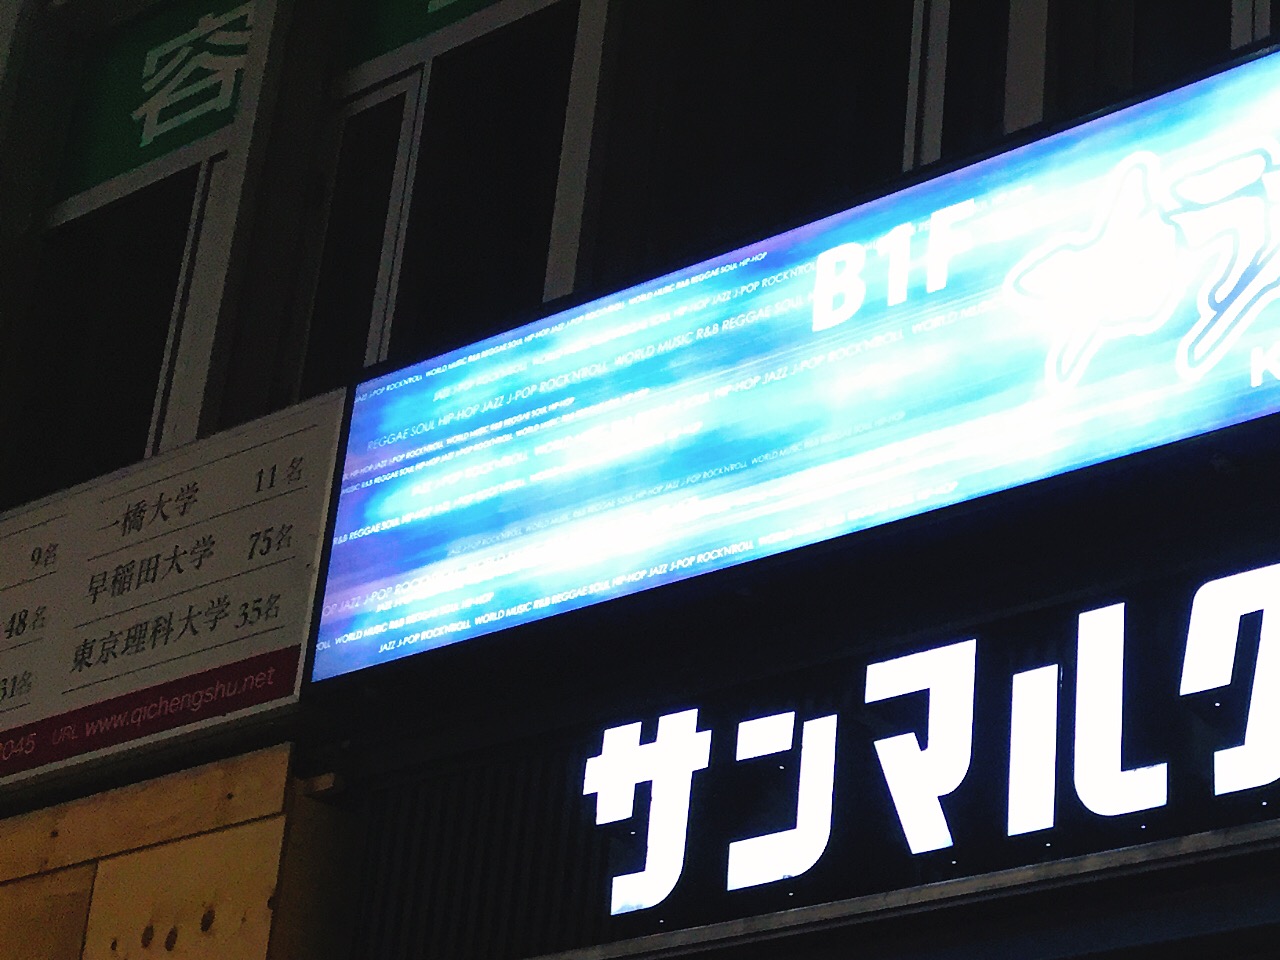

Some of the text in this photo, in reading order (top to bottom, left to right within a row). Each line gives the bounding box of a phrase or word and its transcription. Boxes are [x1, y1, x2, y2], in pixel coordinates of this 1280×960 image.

[129, 2, 256, 148] 容
[811, 199, 977, 331] B1F
[366, 428, 409, 453] REGGAE
[410, 419, 435, 438] SOUL
[437, 403, 480, 428] HIP-HOP
[480, 395, 504, 414] JAZZ
[506, 384, 537, 405] J-POP
[613, 343, 655, 368] WORLD
[657, 330, 693, 354] MUSIC
[695, 321, 719, 341] R&B
[721, 303, 771, 332] REGGAE
[99, 457, 305, 537] 一橋大学 11名
[85, 523, 294, 604] 早稲田大学 75名
[5, 605, 48, 639] 48名
[69, 593, 282, 674] 東京理科大学 35名
[0, 666, 276, 761] 045 URL www.qichengshu.net
